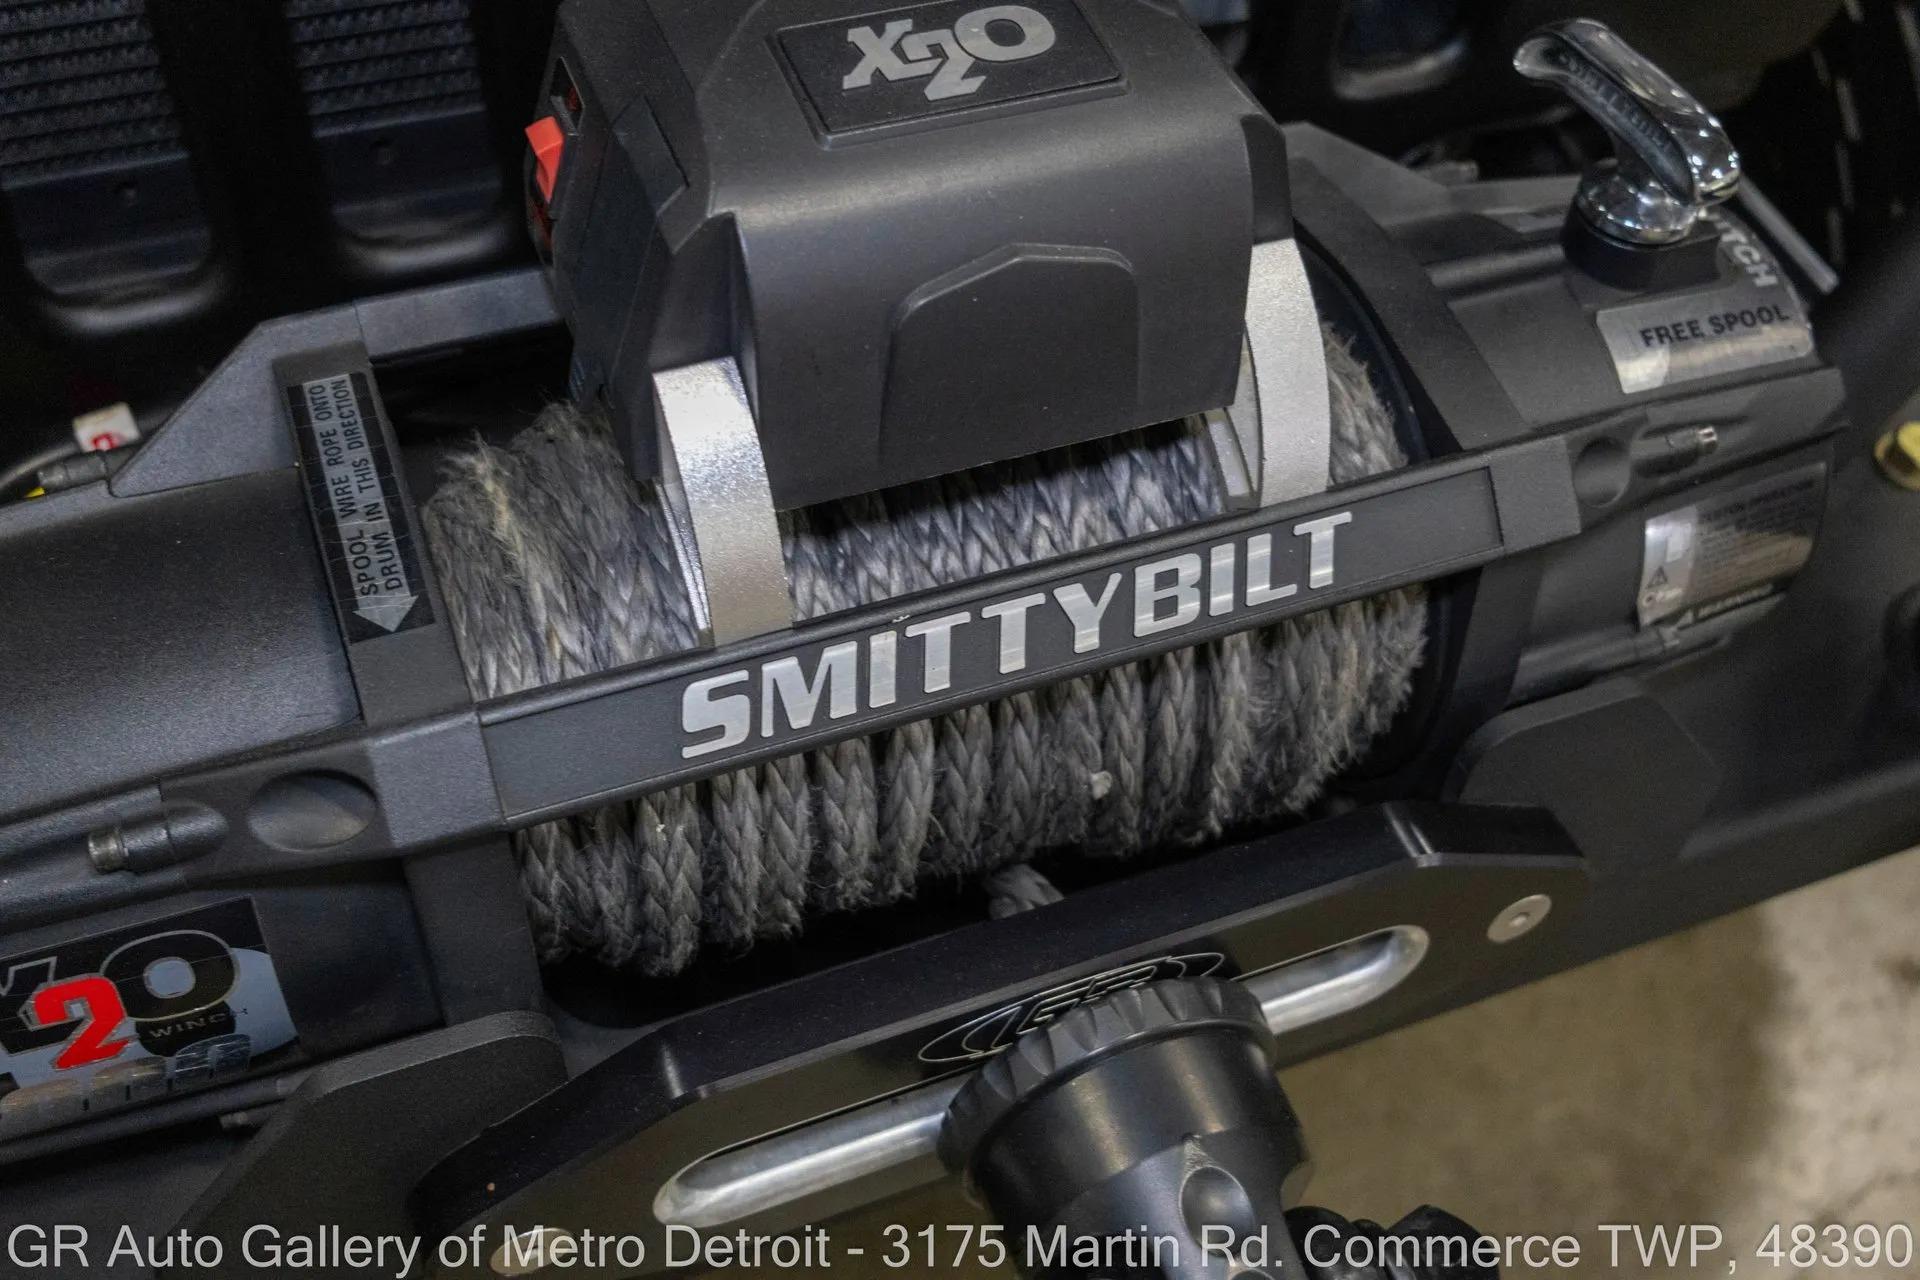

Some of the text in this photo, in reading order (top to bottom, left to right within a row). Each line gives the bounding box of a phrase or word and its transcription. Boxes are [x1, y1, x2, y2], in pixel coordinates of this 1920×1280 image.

[842, 5, 1056, 101] X2O
[1640, 304, 1790, 348] FREE SPOOL
[310, 384, 379, 596] SPOOL WIRE ROPE ONTO
[331, 379, 404, 592] DRUM IN THIS DIRECTION
[681, 511, 1353, 760] SMITTYBILT
[150, 1007, 249, 1039] WINC
